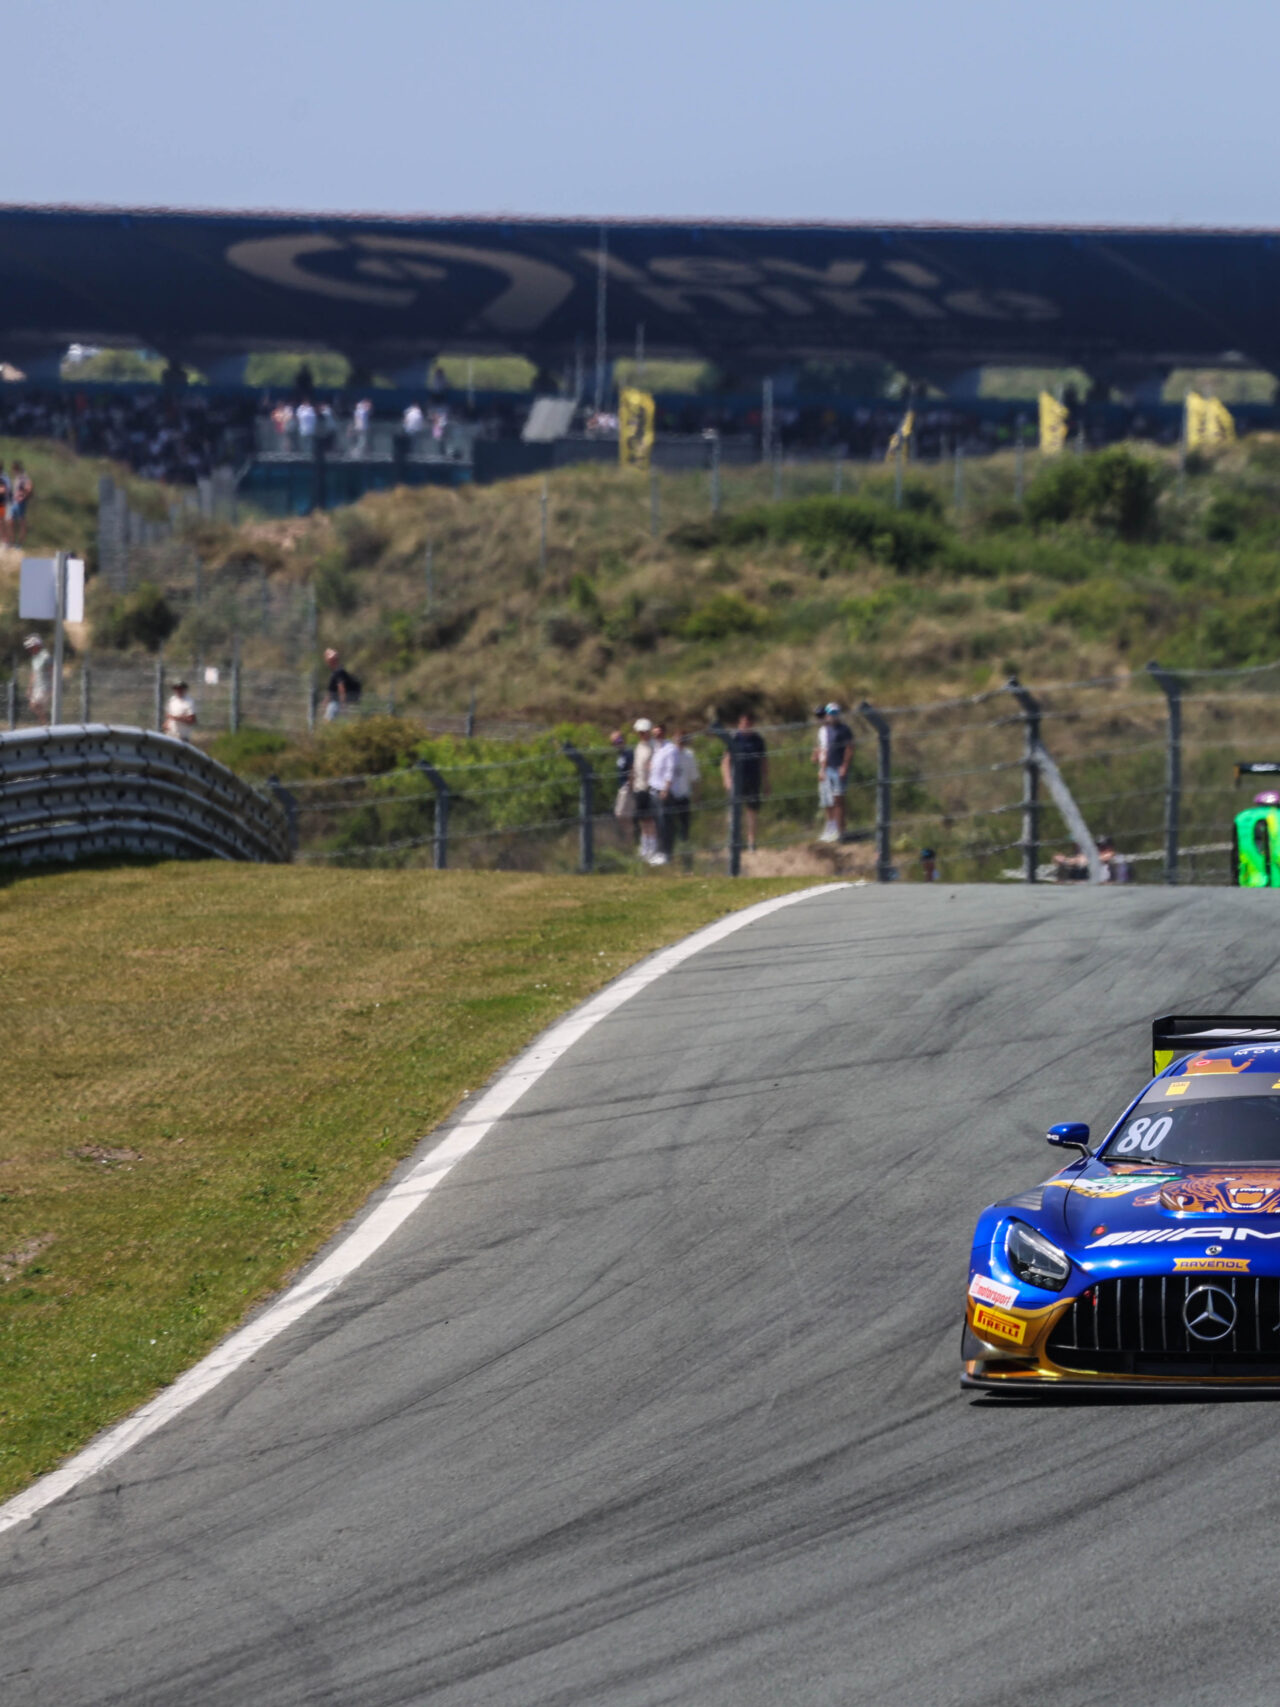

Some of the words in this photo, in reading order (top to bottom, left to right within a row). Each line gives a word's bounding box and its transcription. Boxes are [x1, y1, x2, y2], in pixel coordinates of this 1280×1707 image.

[1117, 1116, 1173, 1153] 80
[1180, 1260, 1244, 1270] RAVENOL
[977, 1282, 1012, 1308] motorsport
[978, 1308, 1022, 1339] PIRELLI
